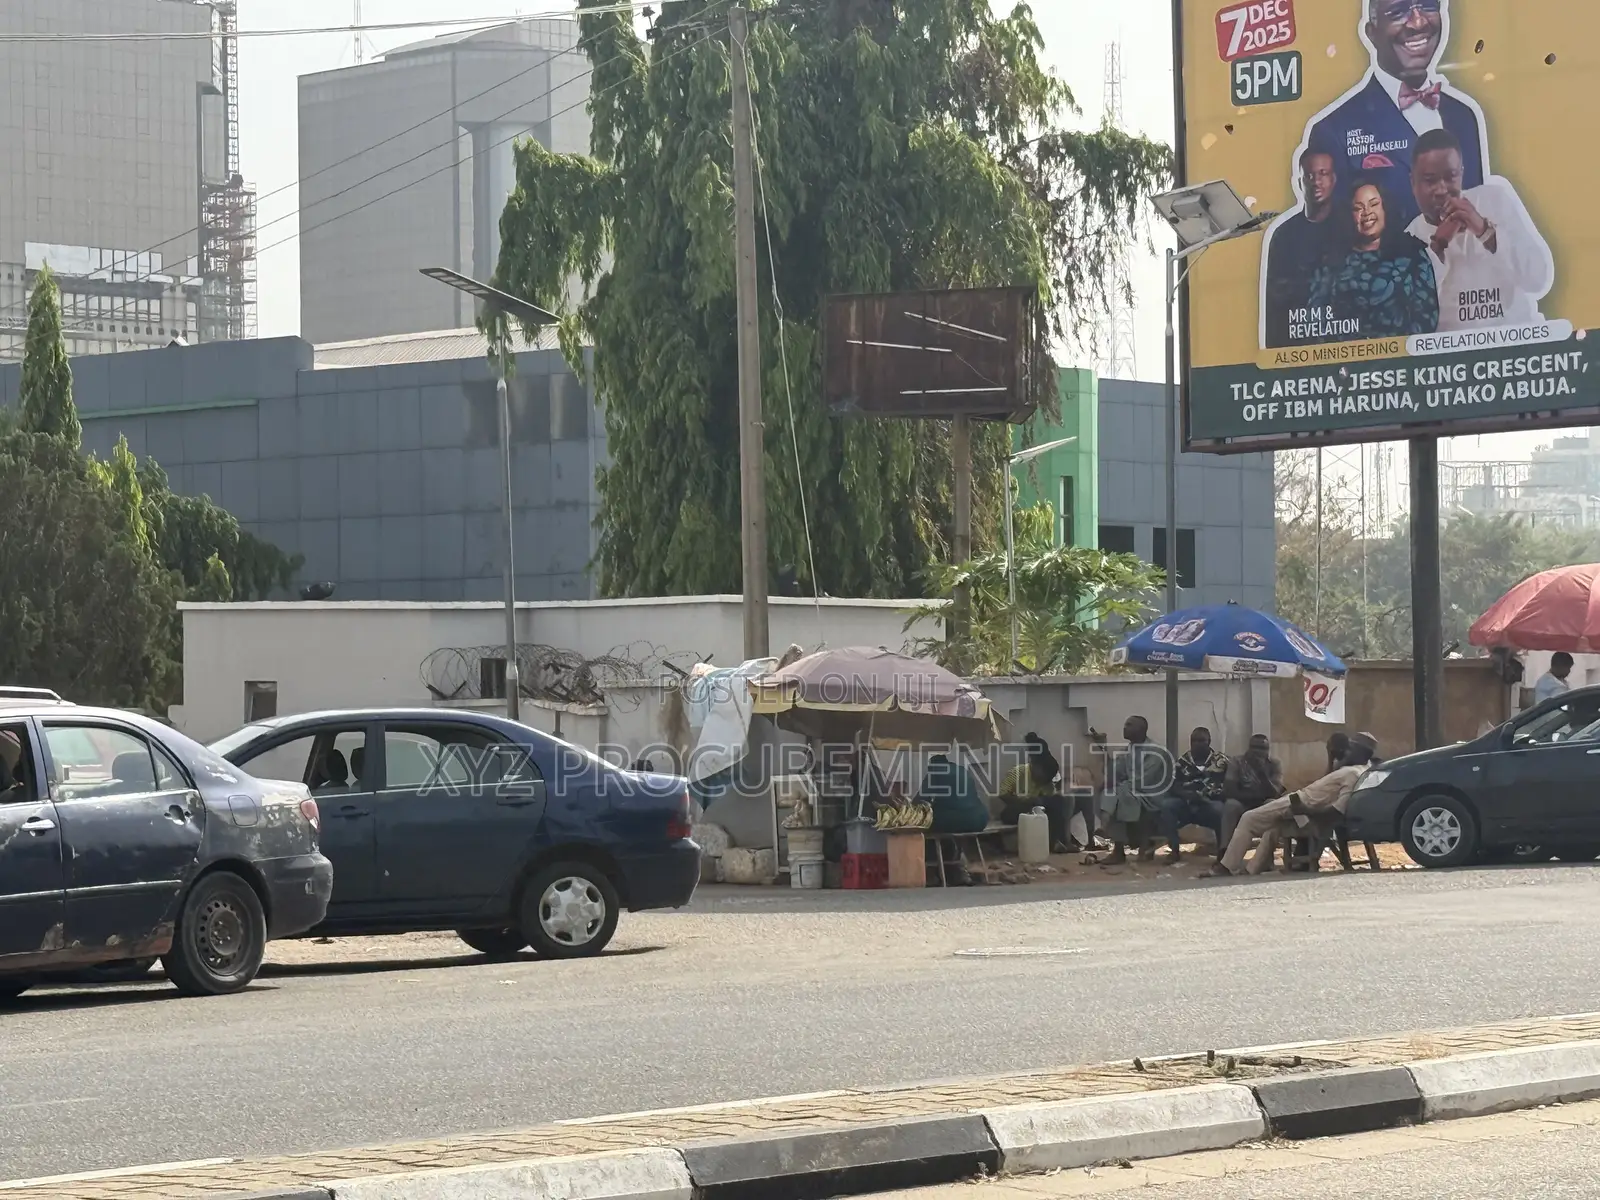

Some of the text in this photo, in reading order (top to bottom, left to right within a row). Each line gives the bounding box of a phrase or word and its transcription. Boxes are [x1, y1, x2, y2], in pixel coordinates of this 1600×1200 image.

[1220, 0, 1288, 57] 7 DEC
[1242, 20, 1291, 51] 2025
[1236, 56, 1297, 99] 5PM
[1346, 134, 1375, 147] PASTOR
[1347, 144, 1368, 156] ODUN
[1458, 288, 1500, 306] BIDEMI
[1288, 305, 1334, 323] MR M &
[1458, 303, 1504, 321] OLAOBA
[1289, 318, 1359, 339] REVELATION
[1415, 325, 1549, 351] REVELATION VOICES
[1274, 341, 1399, 365] ALSO MINISTERING
[1230, 351, 1589, 401] TLC ARENA, JESSE KING CRESCENT,
[1242, 376, 1577, 422] OFF IBM HARUNA, UTAKO ABUJA.
